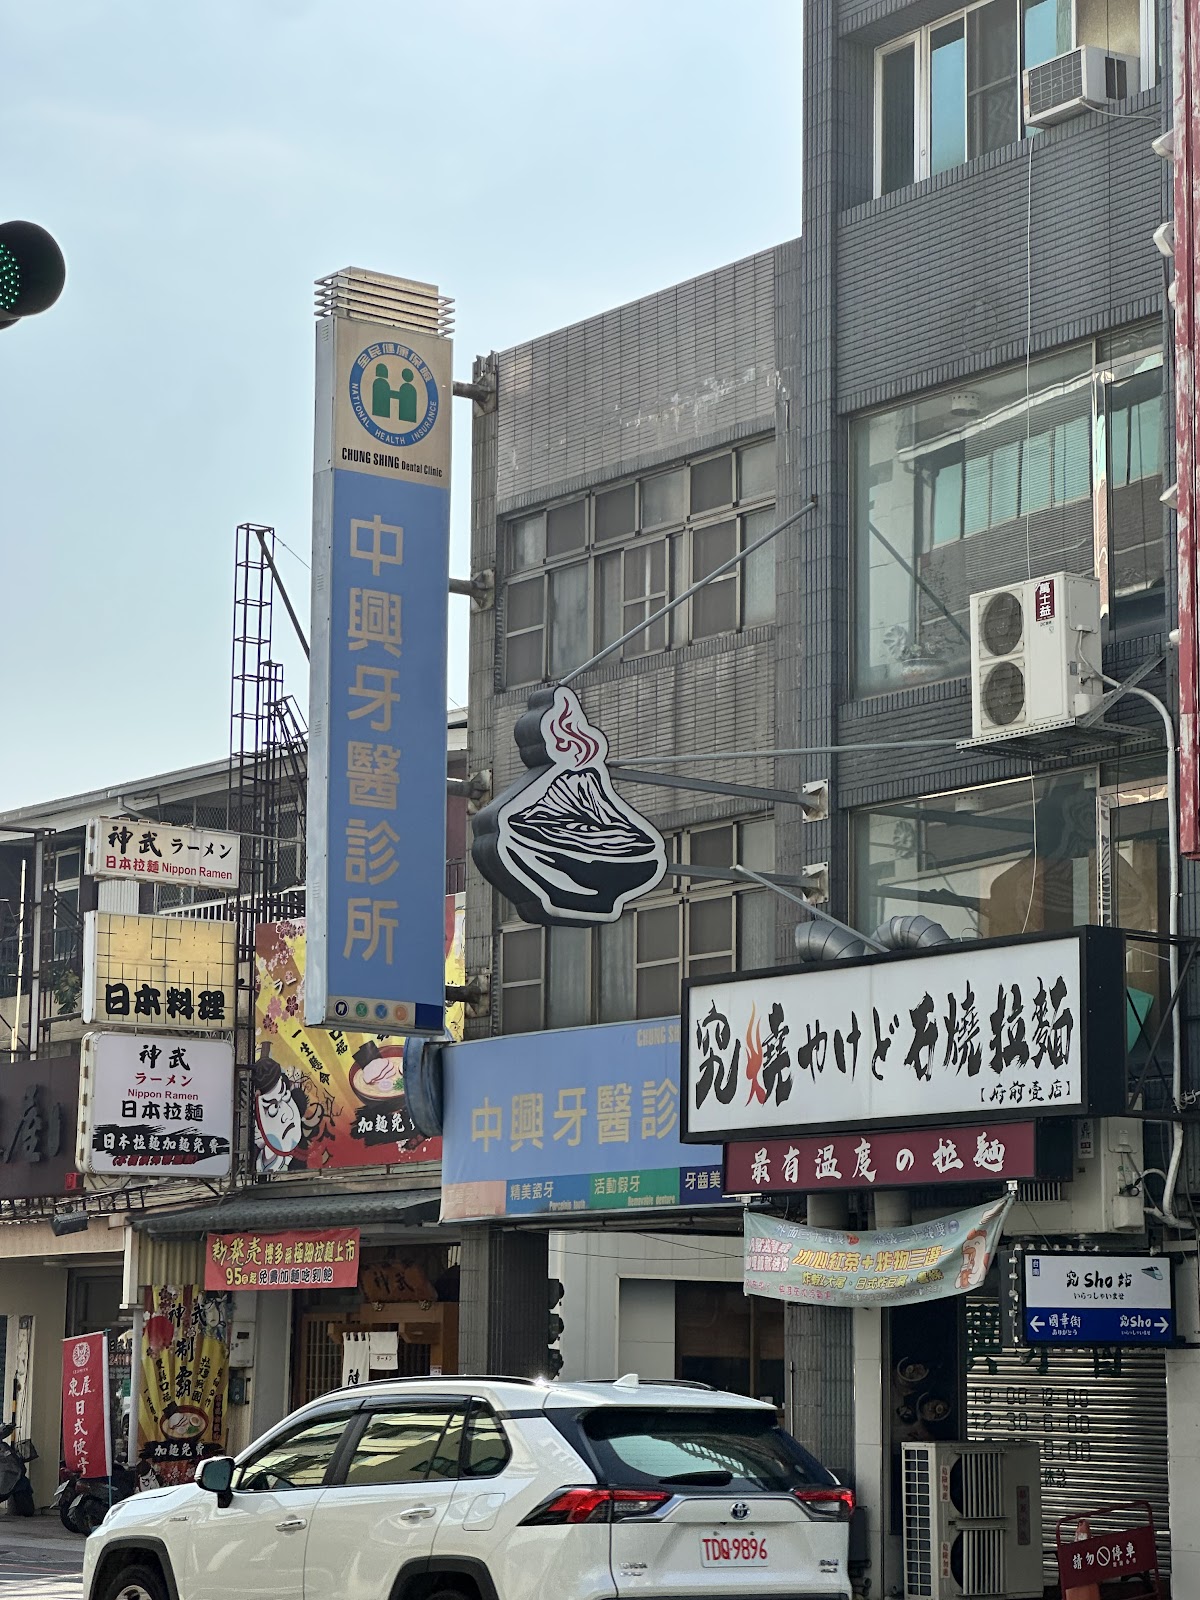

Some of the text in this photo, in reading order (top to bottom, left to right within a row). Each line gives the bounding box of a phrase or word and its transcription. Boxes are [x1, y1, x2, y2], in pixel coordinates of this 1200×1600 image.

[351, 383, 437, 445] NATIONAL HEALTH INSURANCE
[341, 447, 443, 477] CHUNG SHING Dental Clinic
[342, 514, 404, 965] 中興牙醫診所
[108, 826, 232, 860] 神武 ラーメン
[162, 863, 197, 876] Nippon
[200, 867, 233, 880] Ramen
[105, 983, 226, 1020] 日本料理
[637, 1029, 666, 1046] CHUNG
[139, 1044, 191, 1071] 神武
[134, 1072, 193, 1087] ラーメン
[127, 1088, 199, 1101] Nippon Ramen
[121, 1100, 204, 1122] 日本拉麵
[471, 1078, 679, 1152] 中興牙醫診
[510, 1181, 554, 1201] 精美瓷牙
[594, 1175, 640, 1195] 活動假牙
[1073, 1291, 1125, 1301] いらっしゃいませ
